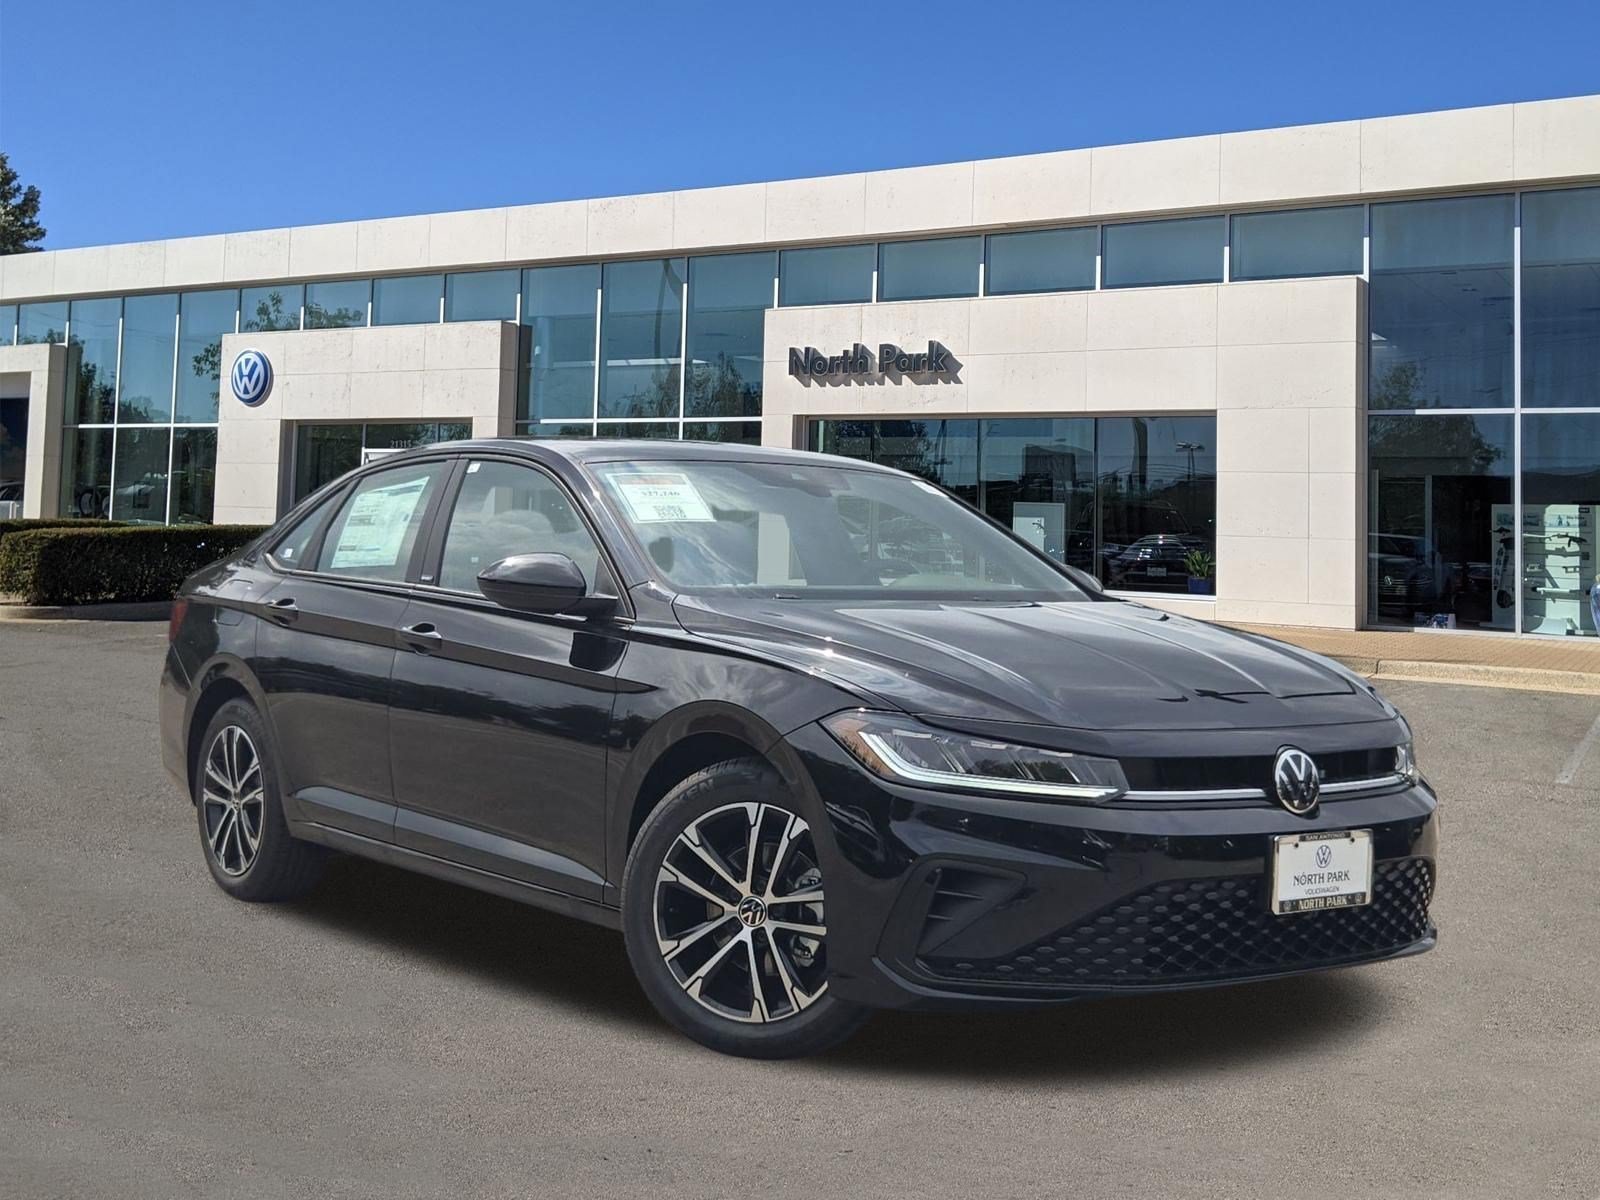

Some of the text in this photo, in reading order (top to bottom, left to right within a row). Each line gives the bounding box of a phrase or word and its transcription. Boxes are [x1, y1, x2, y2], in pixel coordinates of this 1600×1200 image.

[789, 340, 948, 376] North Park
[1293, 870, 1350, 886] NORTH PARK
[1298, 895, 1348, 910] NORTH PARK
